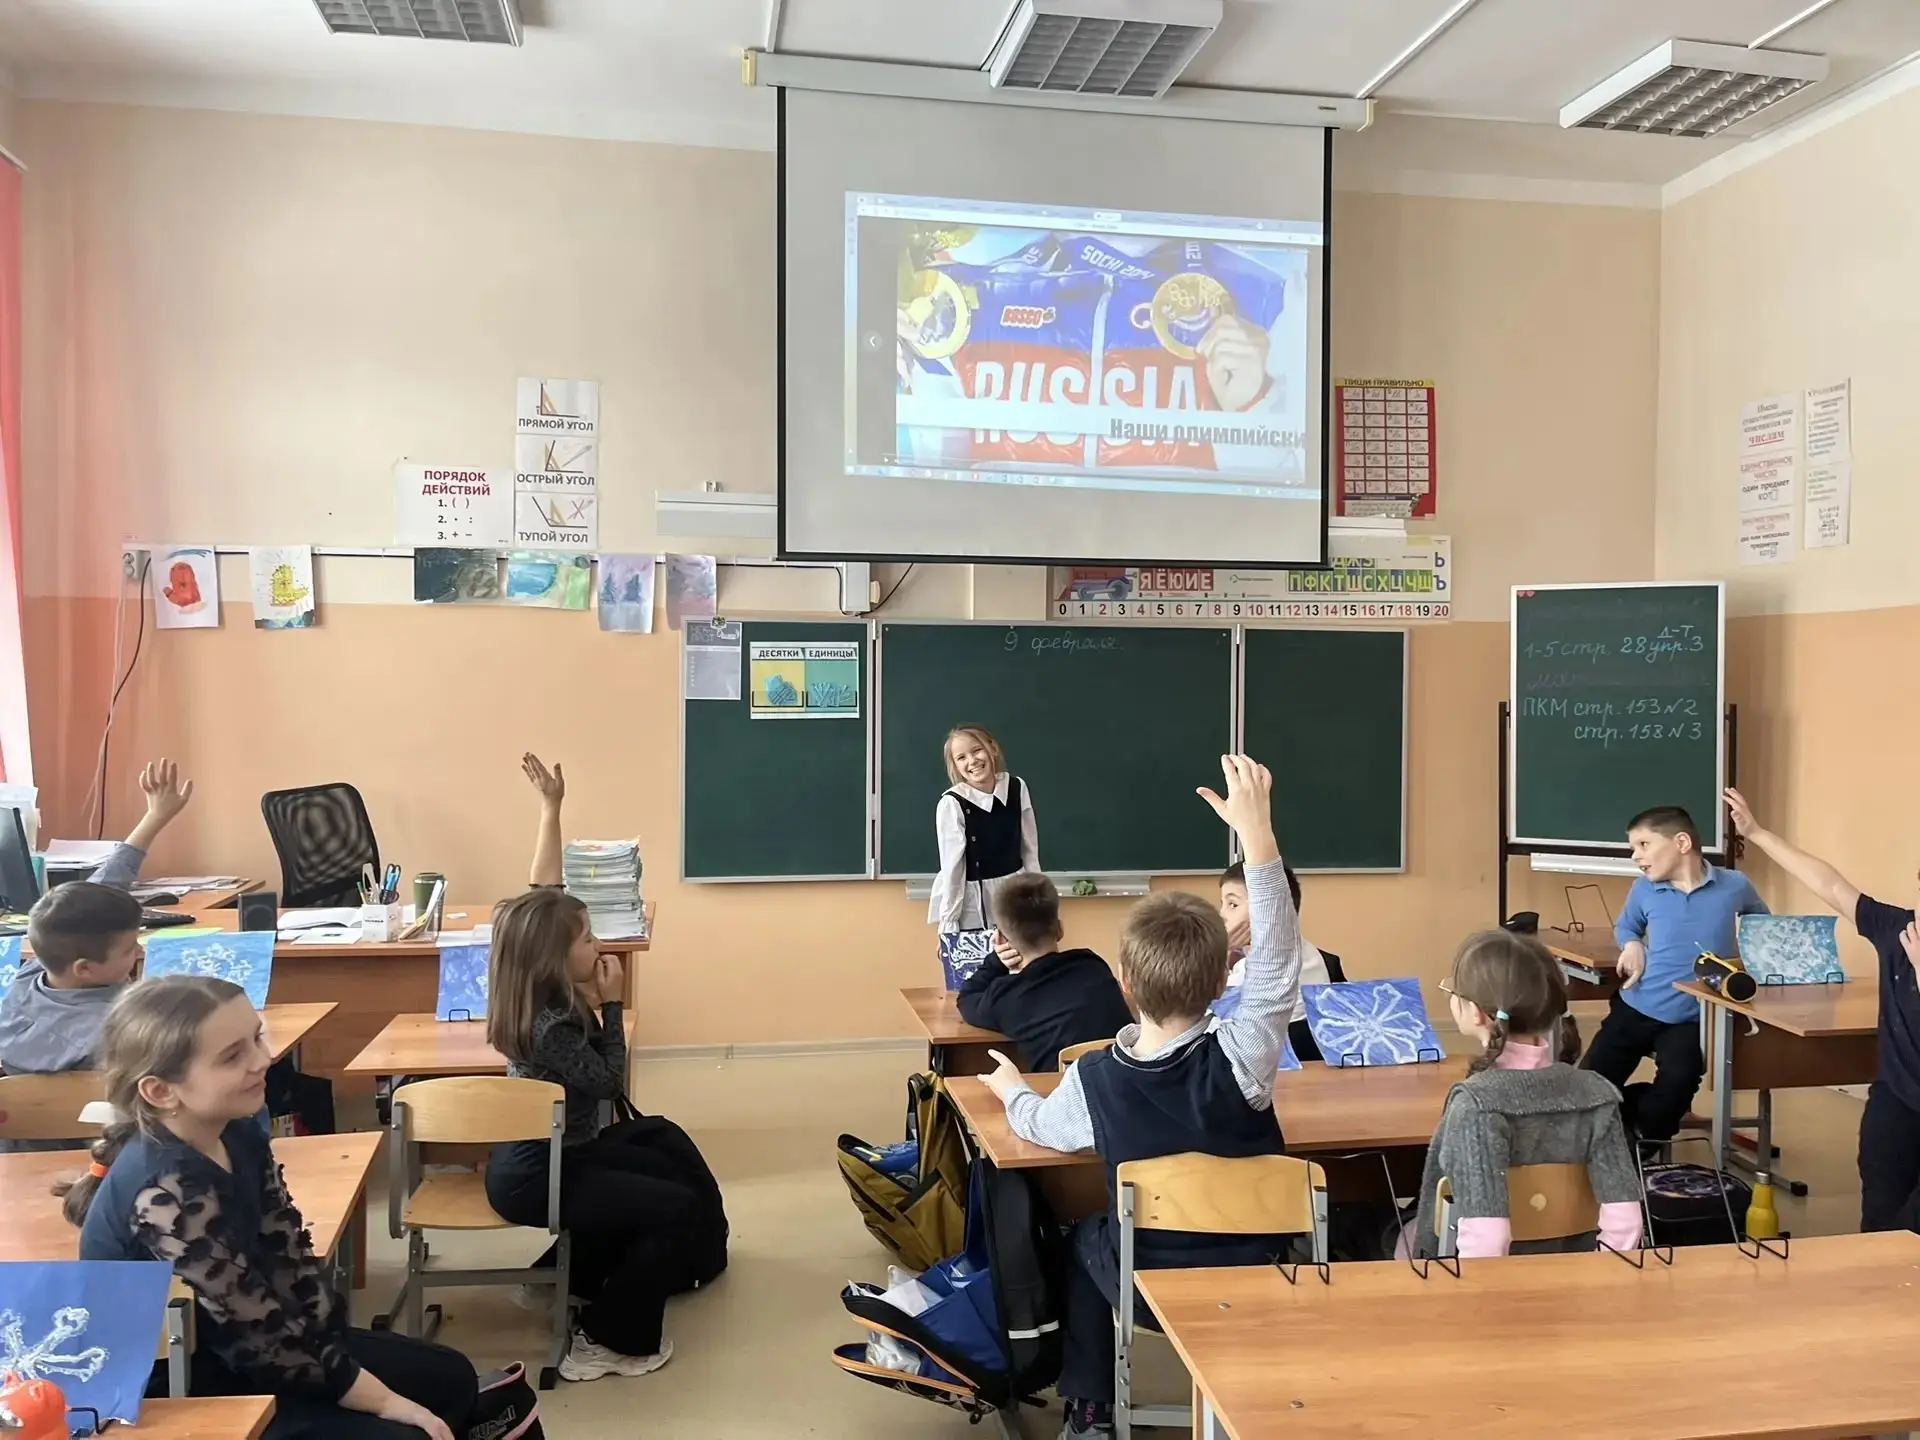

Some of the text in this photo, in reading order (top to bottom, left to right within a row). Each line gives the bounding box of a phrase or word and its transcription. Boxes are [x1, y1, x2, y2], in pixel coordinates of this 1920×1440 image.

[1081, 245, 1124, 271] SOCHI
[518, 417, 594, 431] ПРЯМОЙ УГОЛ
[1110, 418, 1168, 441] Наши
[424, 470, 486, 482] ПОРЯДОК
[517, 473, 595, 486] ОСТРЫЙ УГОЛ
[422, 483, 490, 496] ДЕЙСТВИЙ
[437, 499, 447, 508] 1.
[437, 515, 447, 524] 2.
[437, 531, 447, 540] 3.
[518, 530, 588, 544] ТУПОЙ УГОЛ
[1059, 604, 1449, 617] 0 1 2 3 4 5 6 7 8 9 10 11 12 13 14 15 16 17 18 19 20
[1004, 631, 1018, 651] 9
[759, 650, 853, 658] ДЕСЯТКИ ЕДИНИЦЫ
[1523, 698, 1567, 718] ПКМ
